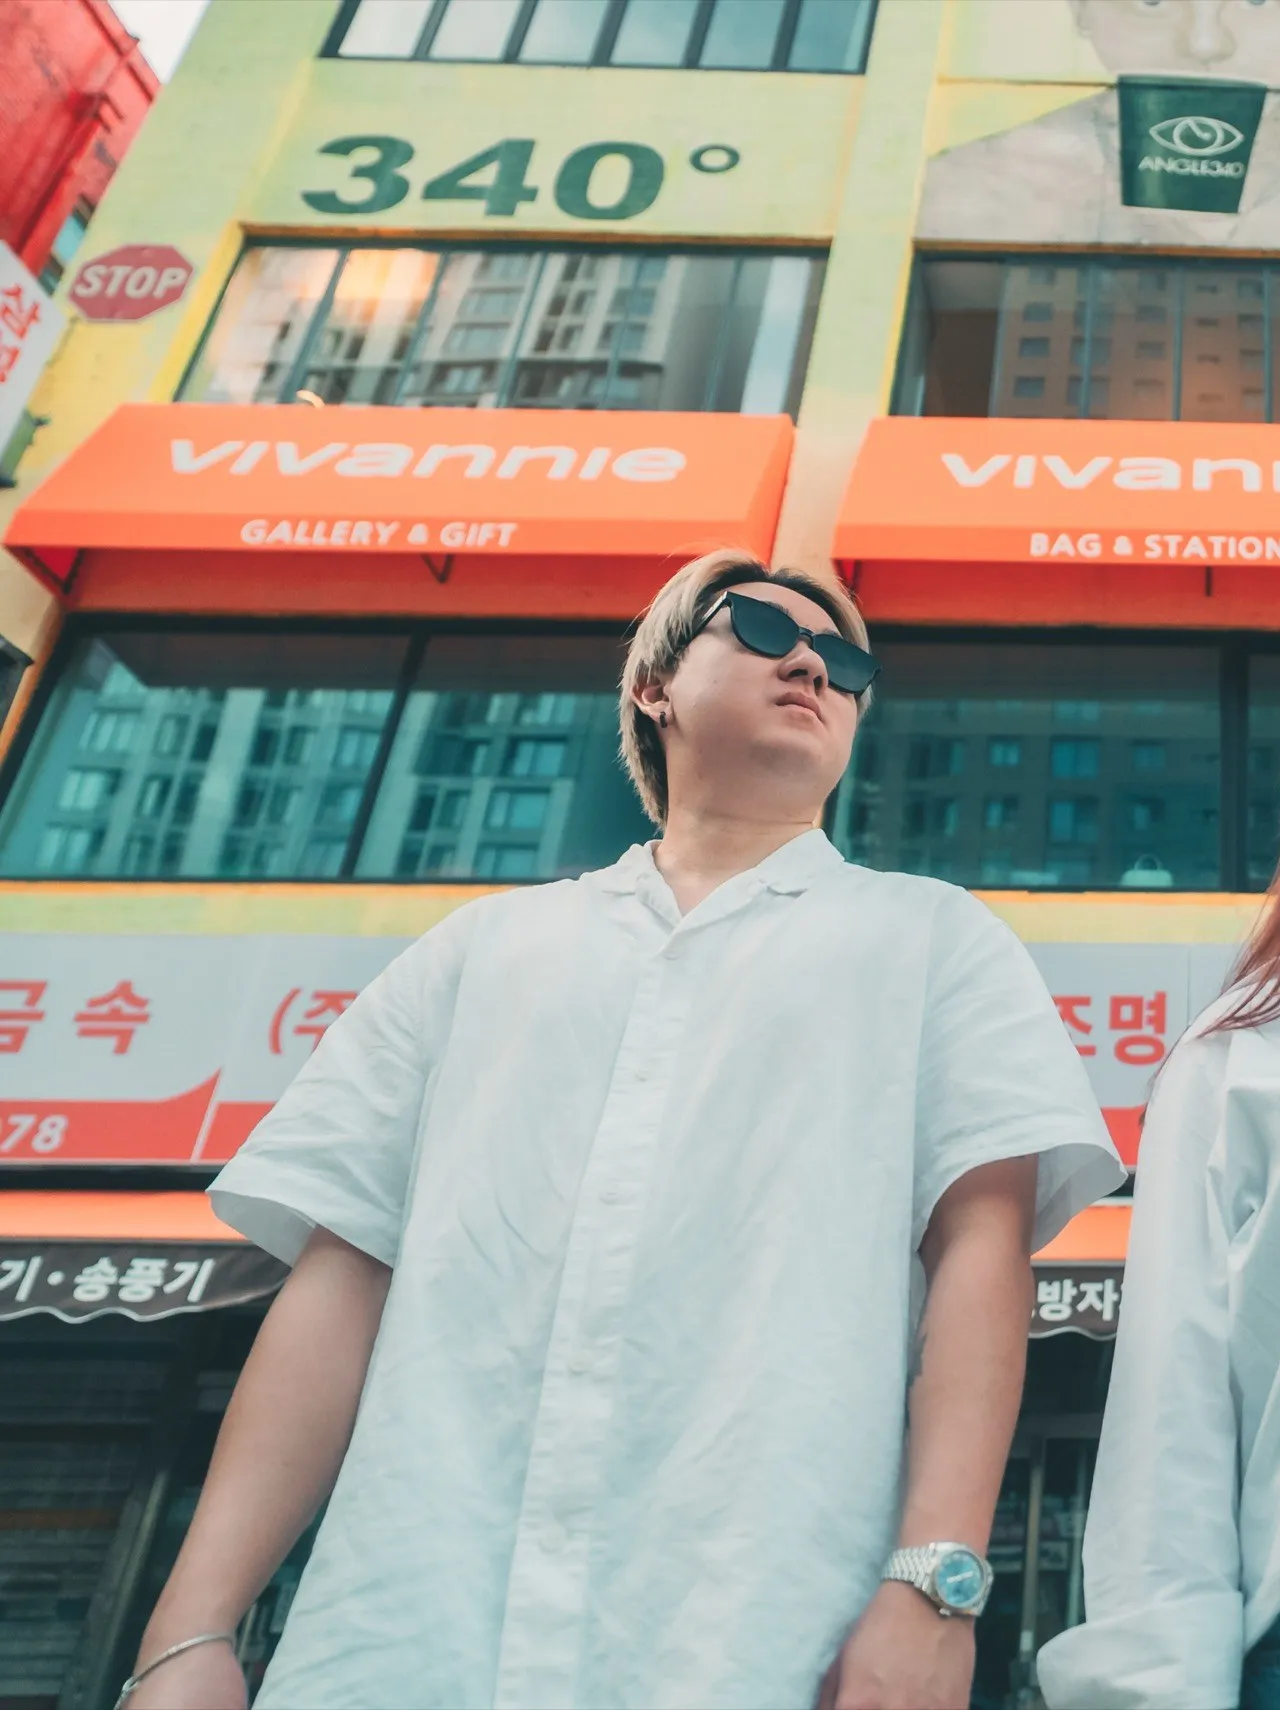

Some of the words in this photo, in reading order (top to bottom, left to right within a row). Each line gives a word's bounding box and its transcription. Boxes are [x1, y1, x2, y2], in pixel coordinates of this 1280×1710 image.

[73, 264, 188, 299] STOP
[170, 439, 687, 482] vivannie
[240, 519, 401, 546] GALLERY
[406, 522, 429, 545] &
[440, 522, 518, 547] GIFT
[1029, 533, 1101, 558] BAG
[1113, 535, 1133, 557] &
[0, 1114, 68, 1152] 78
[1034, 1278, 1122, 1321] 방자
